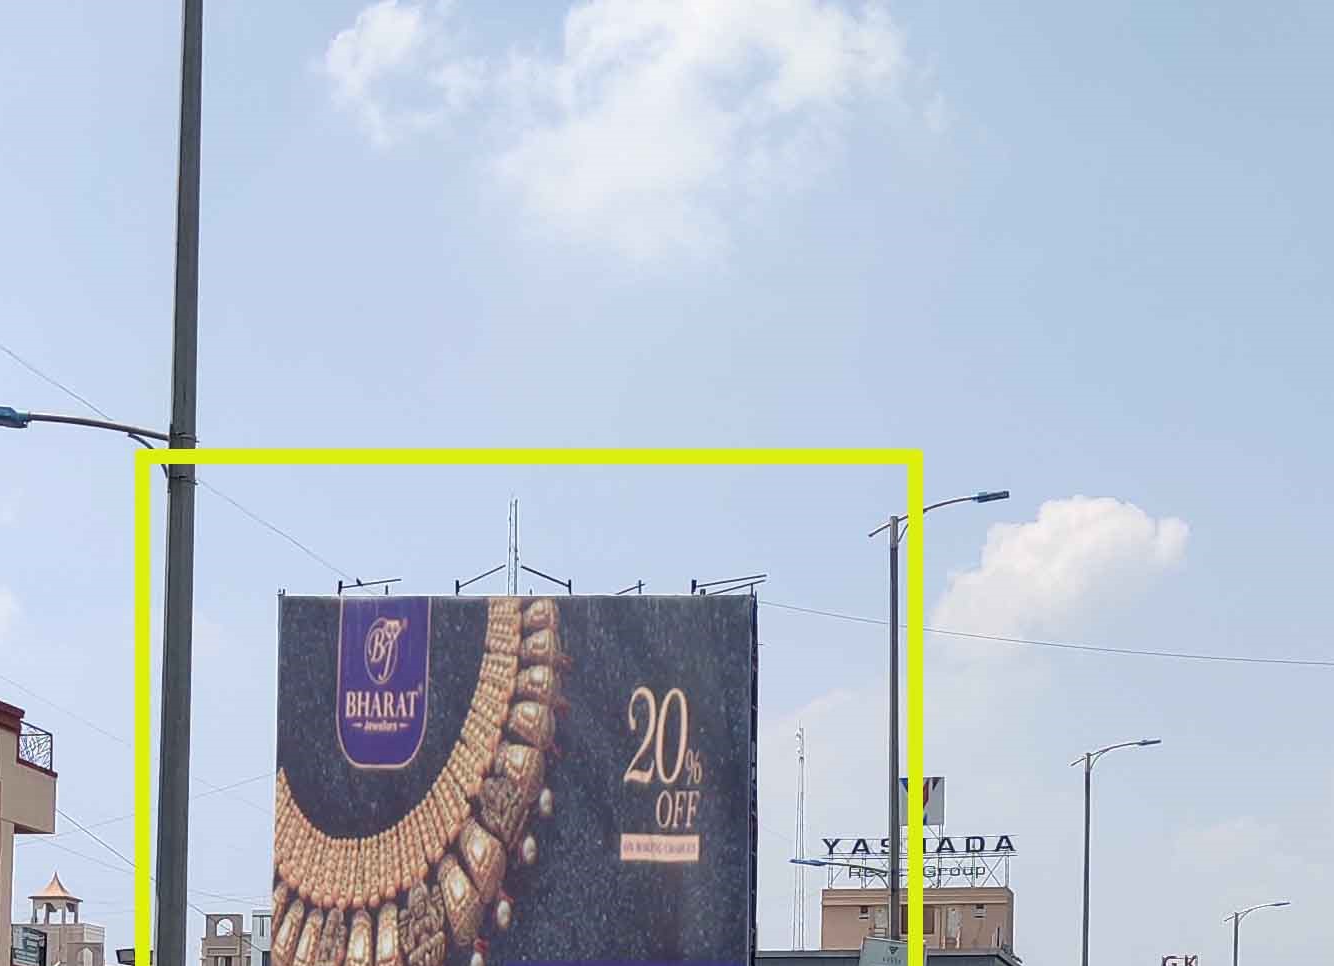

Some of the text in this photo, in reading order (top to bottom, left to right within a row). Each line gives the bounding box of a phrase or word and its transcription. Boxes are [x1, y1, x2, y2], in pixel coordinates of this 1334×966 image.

[346, 690, 419, 719] BHARAT
[655, 790, 701, 829] OFF
[822, 835, 1016, 855] YASADA
